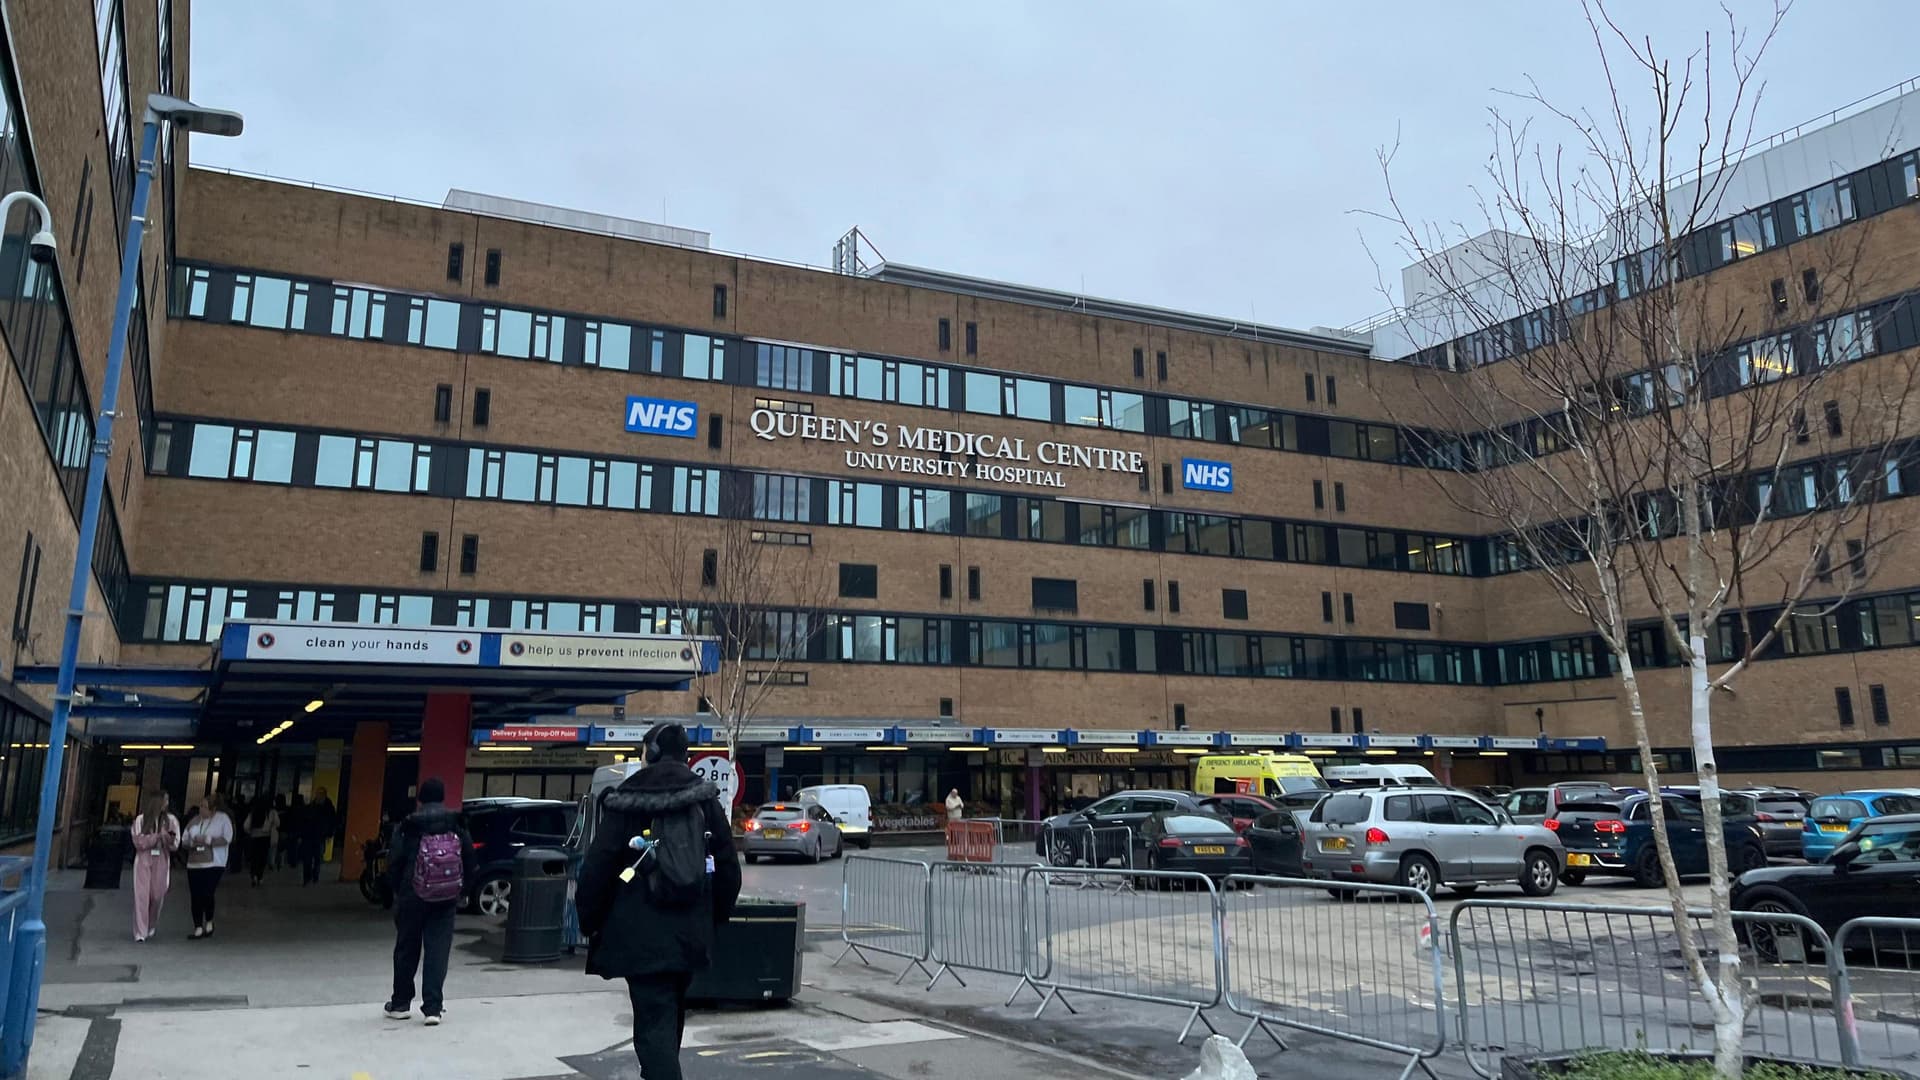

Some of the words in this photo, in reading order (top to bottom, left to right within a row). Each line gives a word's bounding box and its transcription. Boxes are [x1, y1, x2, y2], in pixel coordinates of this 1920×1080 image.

[628, 402, 695, 431] NHS
[750, 409, 889, 446] QUEEN'S
[898, 425, 1030, 461] MEDICAL
[1037, 441, 1144, 473] CENTRE
[845, 450, 970, 478] UNIVERSITY
[976, 463, 1066, 488] HOSPITAL
[1185, 463, 1231, 487] NHS
[306, 637, 345, 648] clean
[352, 640, 380, 651] your
[386, 640, 429, 650] hands
[528, 645, 554, 656] help
[559, 647, 572, 655] us
[577, 648, 624, 658] prevent
[629, 648, 677, 659] infection
[492, 729, 517, 738] Delivery
[878, 815, 935, 828] Vegetables
